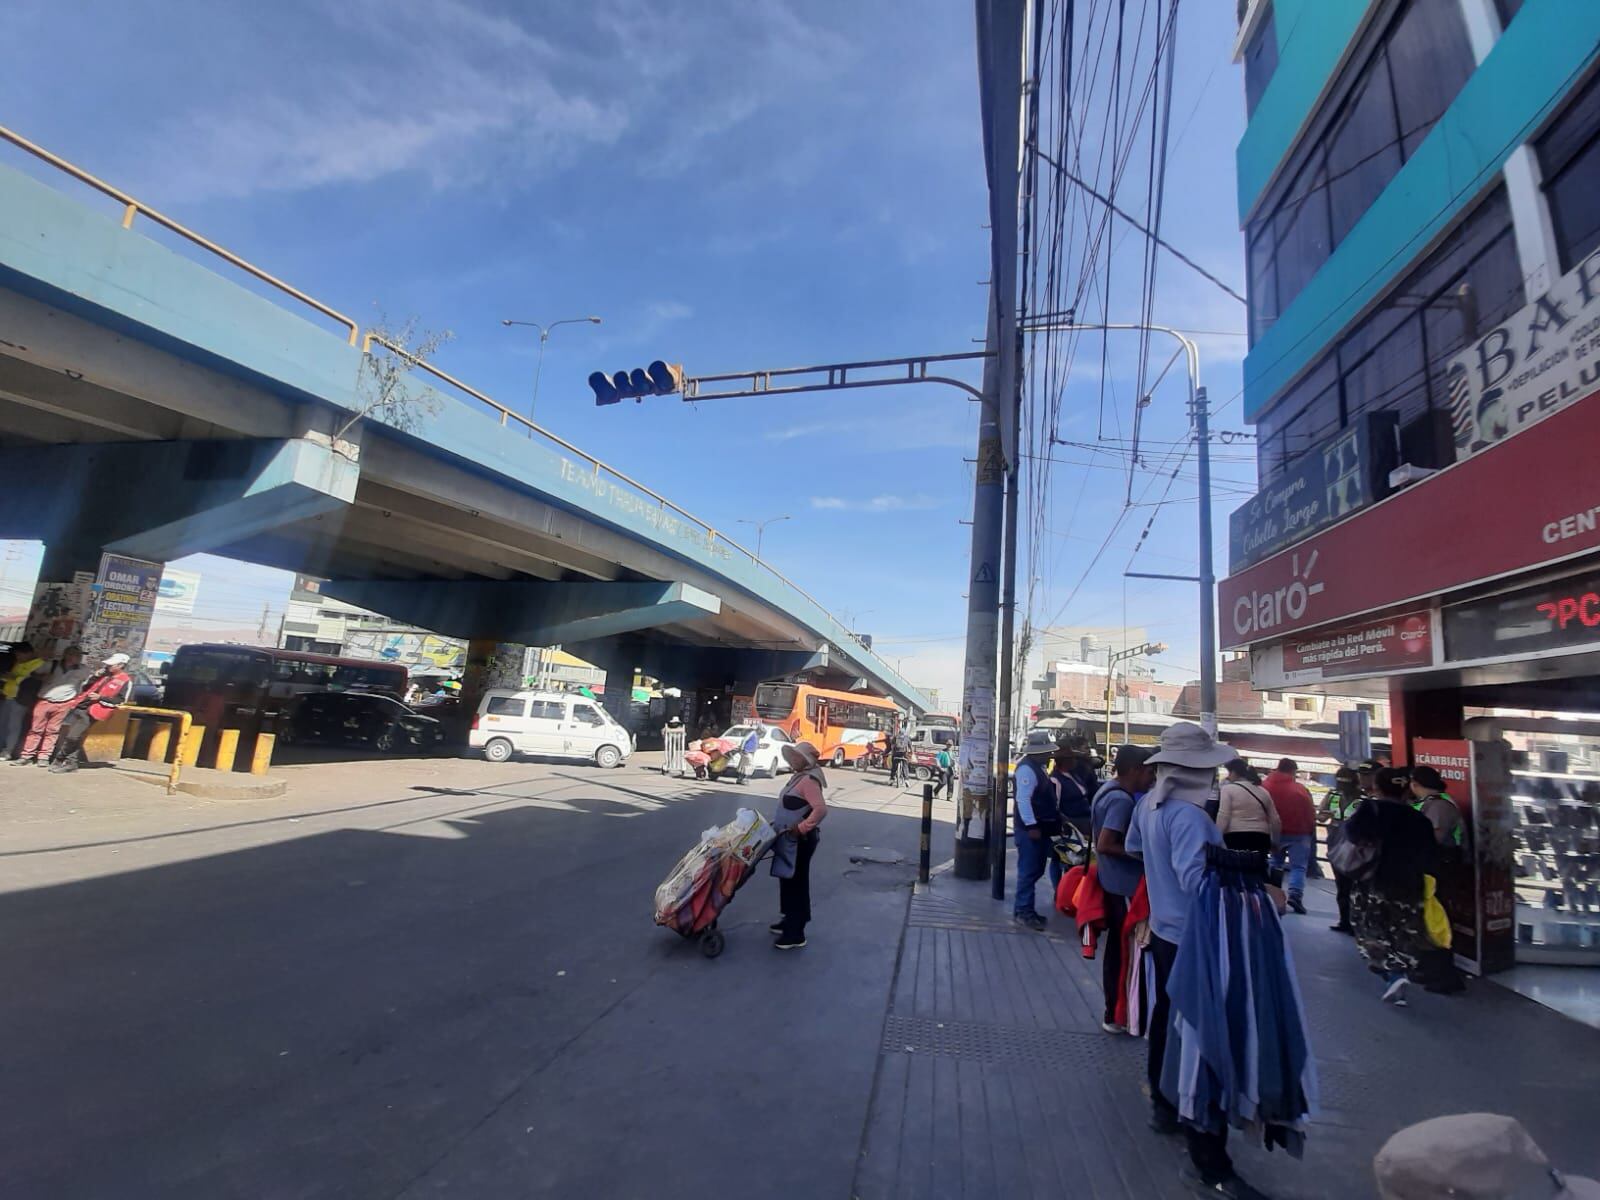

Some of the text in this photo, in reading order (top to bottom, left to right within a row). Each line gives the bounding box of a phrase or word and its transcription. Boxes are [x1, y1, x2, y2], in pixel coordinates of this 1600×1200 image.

[109, 571, 140, 585] OMAR
[1233, 579, 1310, 636] Claro
[1337, 636, 1345, 645] la
[1346, 631, 1363, 644] Red
[1344, 645, 1359, 657] del
